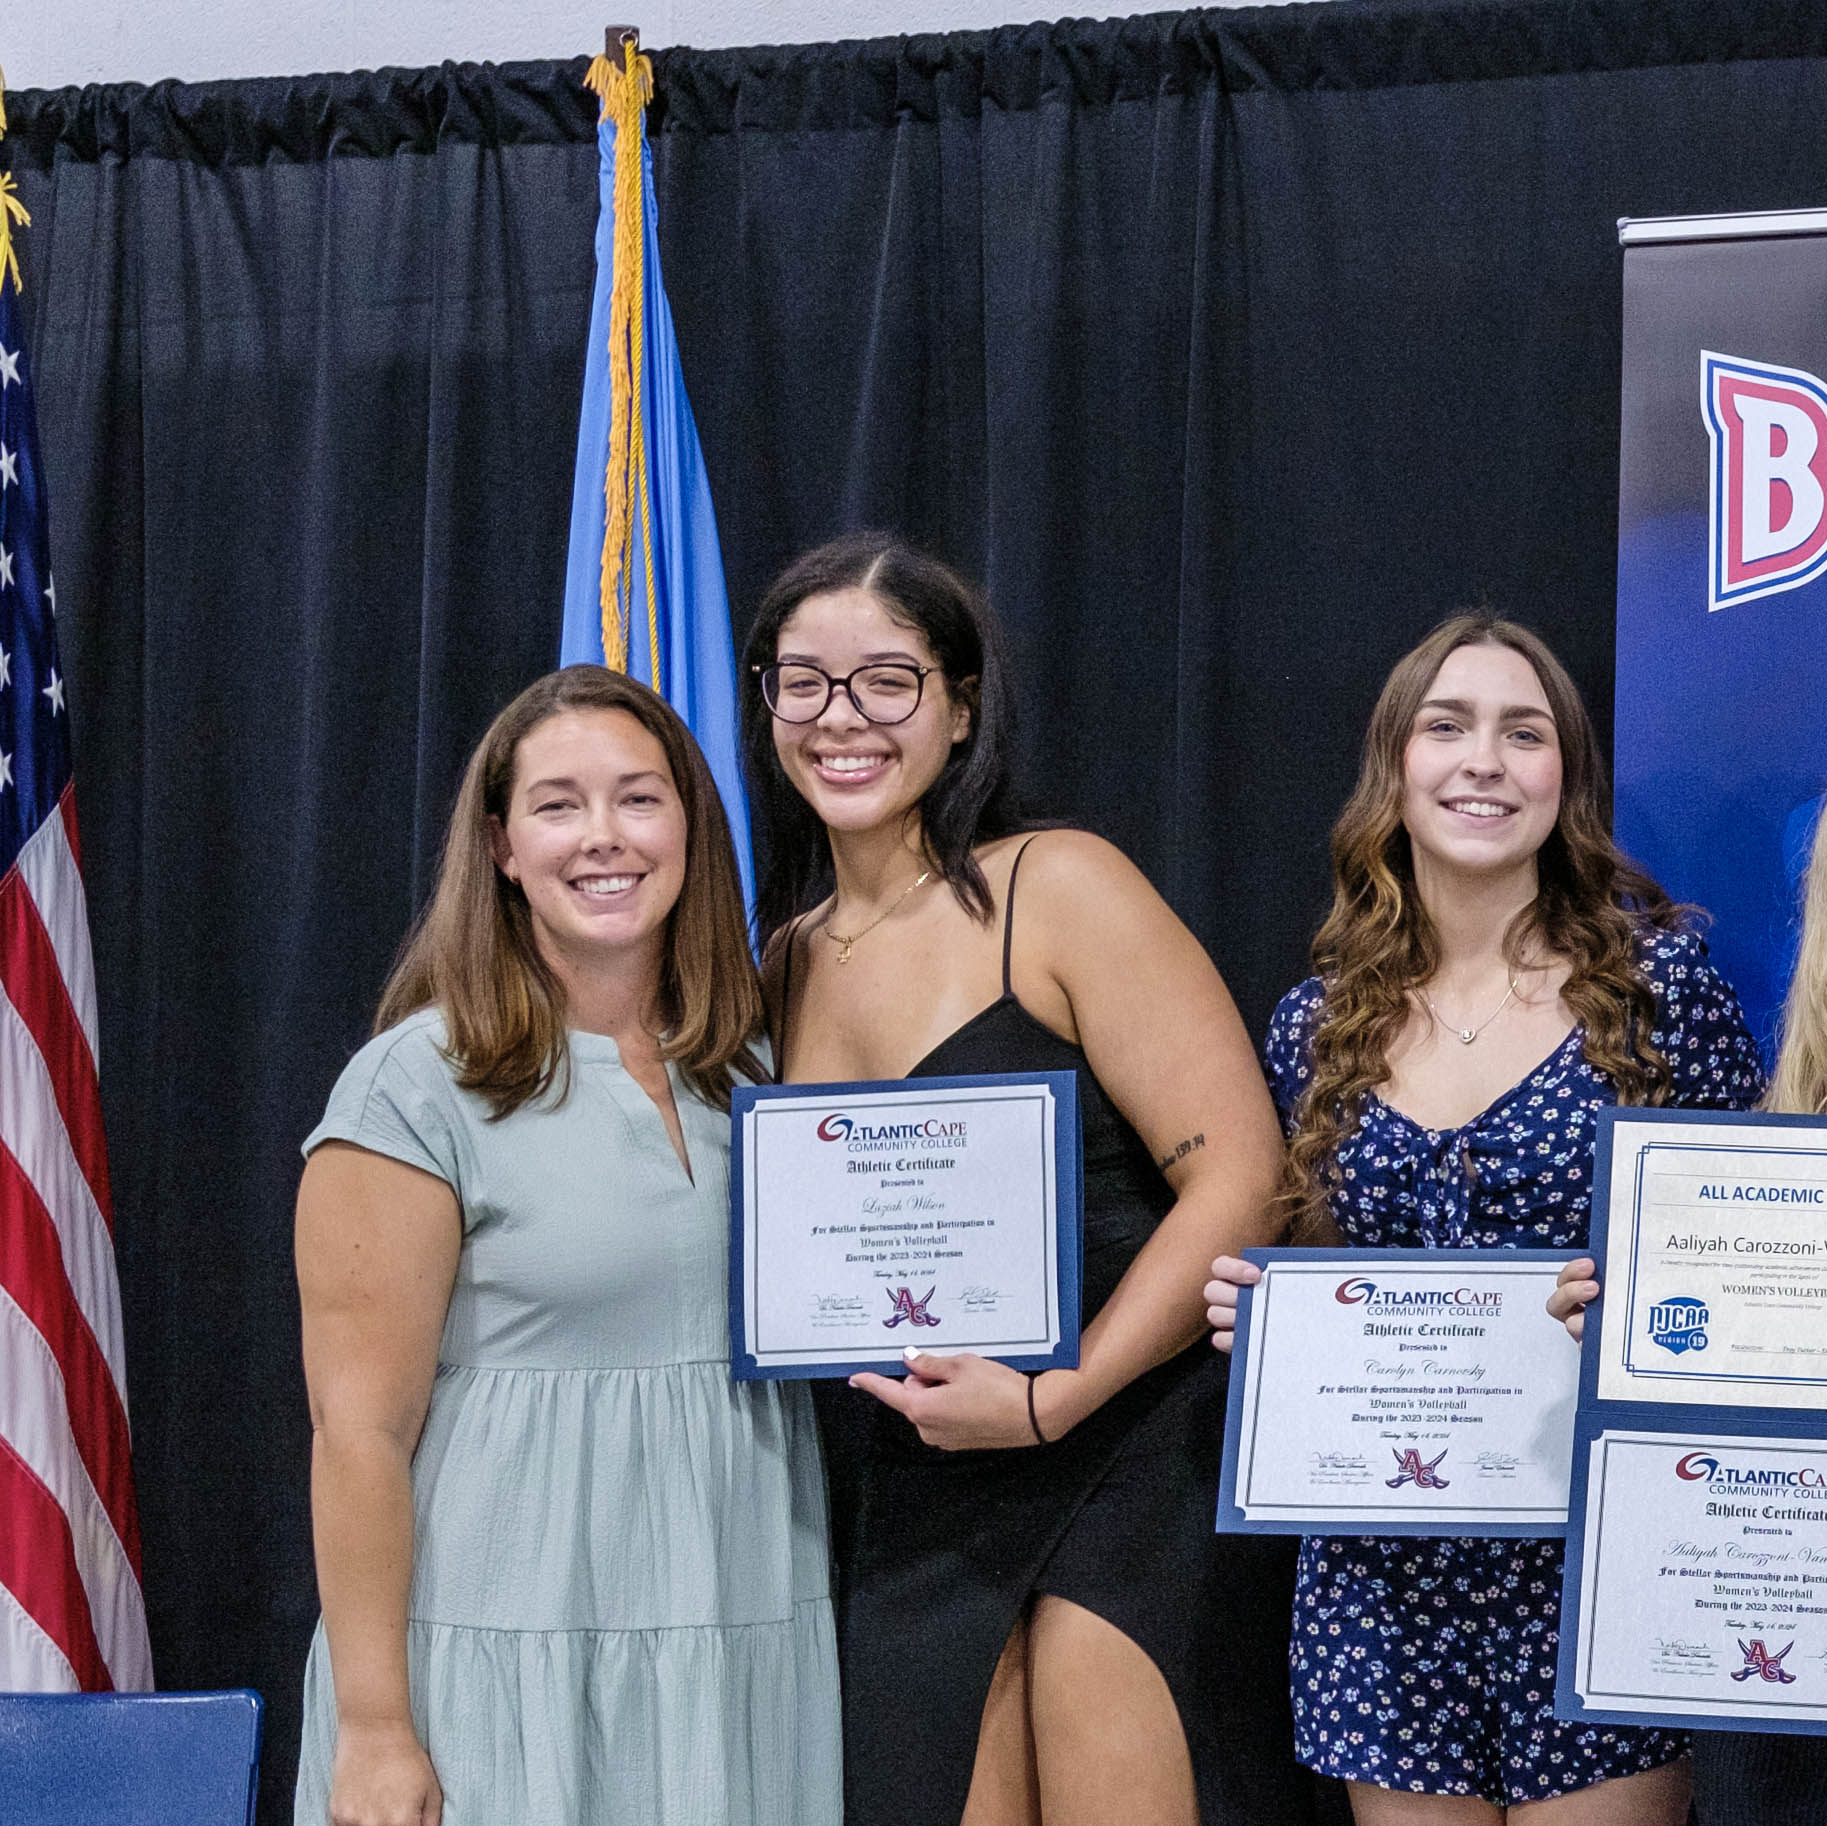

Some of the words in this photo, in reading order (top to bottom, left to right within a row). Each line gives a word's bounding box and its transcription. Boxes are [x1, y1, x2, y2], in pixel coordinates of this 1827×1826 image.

[848, 1140, 917, 1153] COMMUNITY
[921, 1137, 967, 1149] COLLEGE
[846, 1159, 892, 1174] Athletic
[895, 1158, 956, 1172] Certificate
[1698, 1184, 1728, 1200] ALL
[1733, 1186, 1824, 1204] ACADEMIC
[906, 1194, 946, 1211] Wilson
[1666, 1234, 1728, 1255] Aaliyah
[1722, 1284, 1775, 1297] WOMEN'S
[1367, 1306, 1444, 1317] COMMUNITY
[1448, 1306, 1502, 1317] COLLEGE
[1648, 1308, 1709, 1335] NJCAA
[1363, 1324, 1414, 1337] Athletic
[1418, 1324, 1486, 1337] Certificate
[1691, 1336, 1705, 1348] 19
[1709, 1485, 1788, 1498] COMMUNITY
[1705, 1502, 1757, 1519] Athletic
